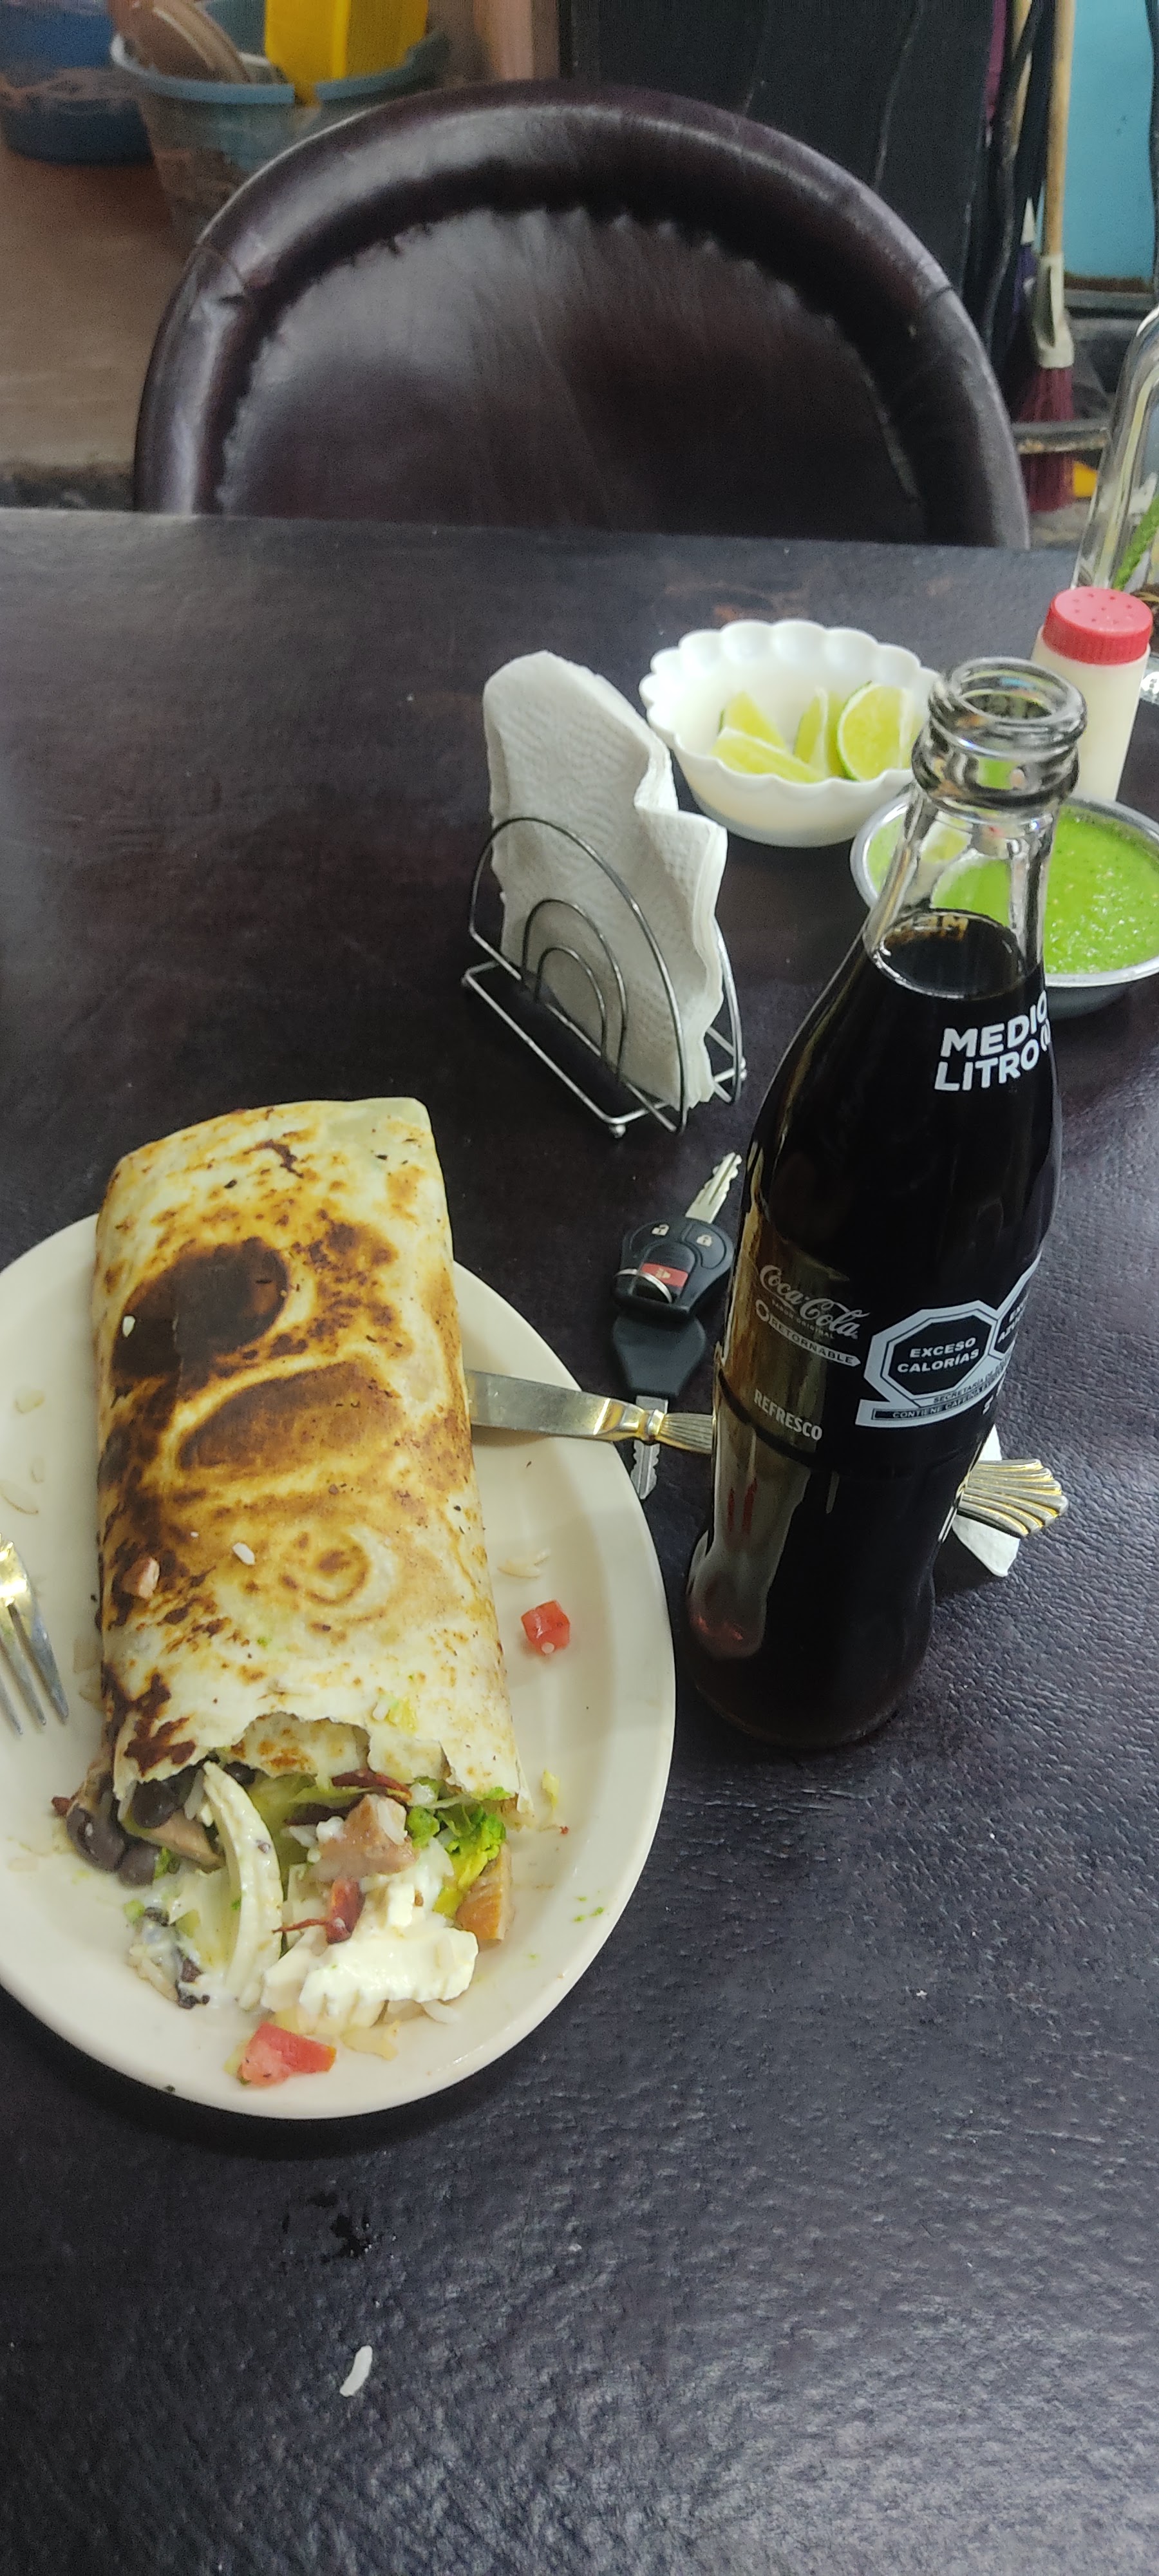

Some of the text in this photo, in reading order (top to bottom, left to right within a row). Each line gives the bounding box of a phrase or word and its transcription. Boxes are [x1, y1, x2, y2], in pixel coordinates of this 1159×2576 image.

[940, 990, 1047, 1058] MEDIO
[934, 1038, 1039, 1091] LITRO
[760, 1265, 871, 1338] Coca-Cola
[771, 1318, 854, 1364] RETORNABLE
[897, 1349, 979, 1373] CALORÍAS
[909, 1337, 976, 1358] EXCESO
[754, 1388, 823, 1441] REFRESCO
